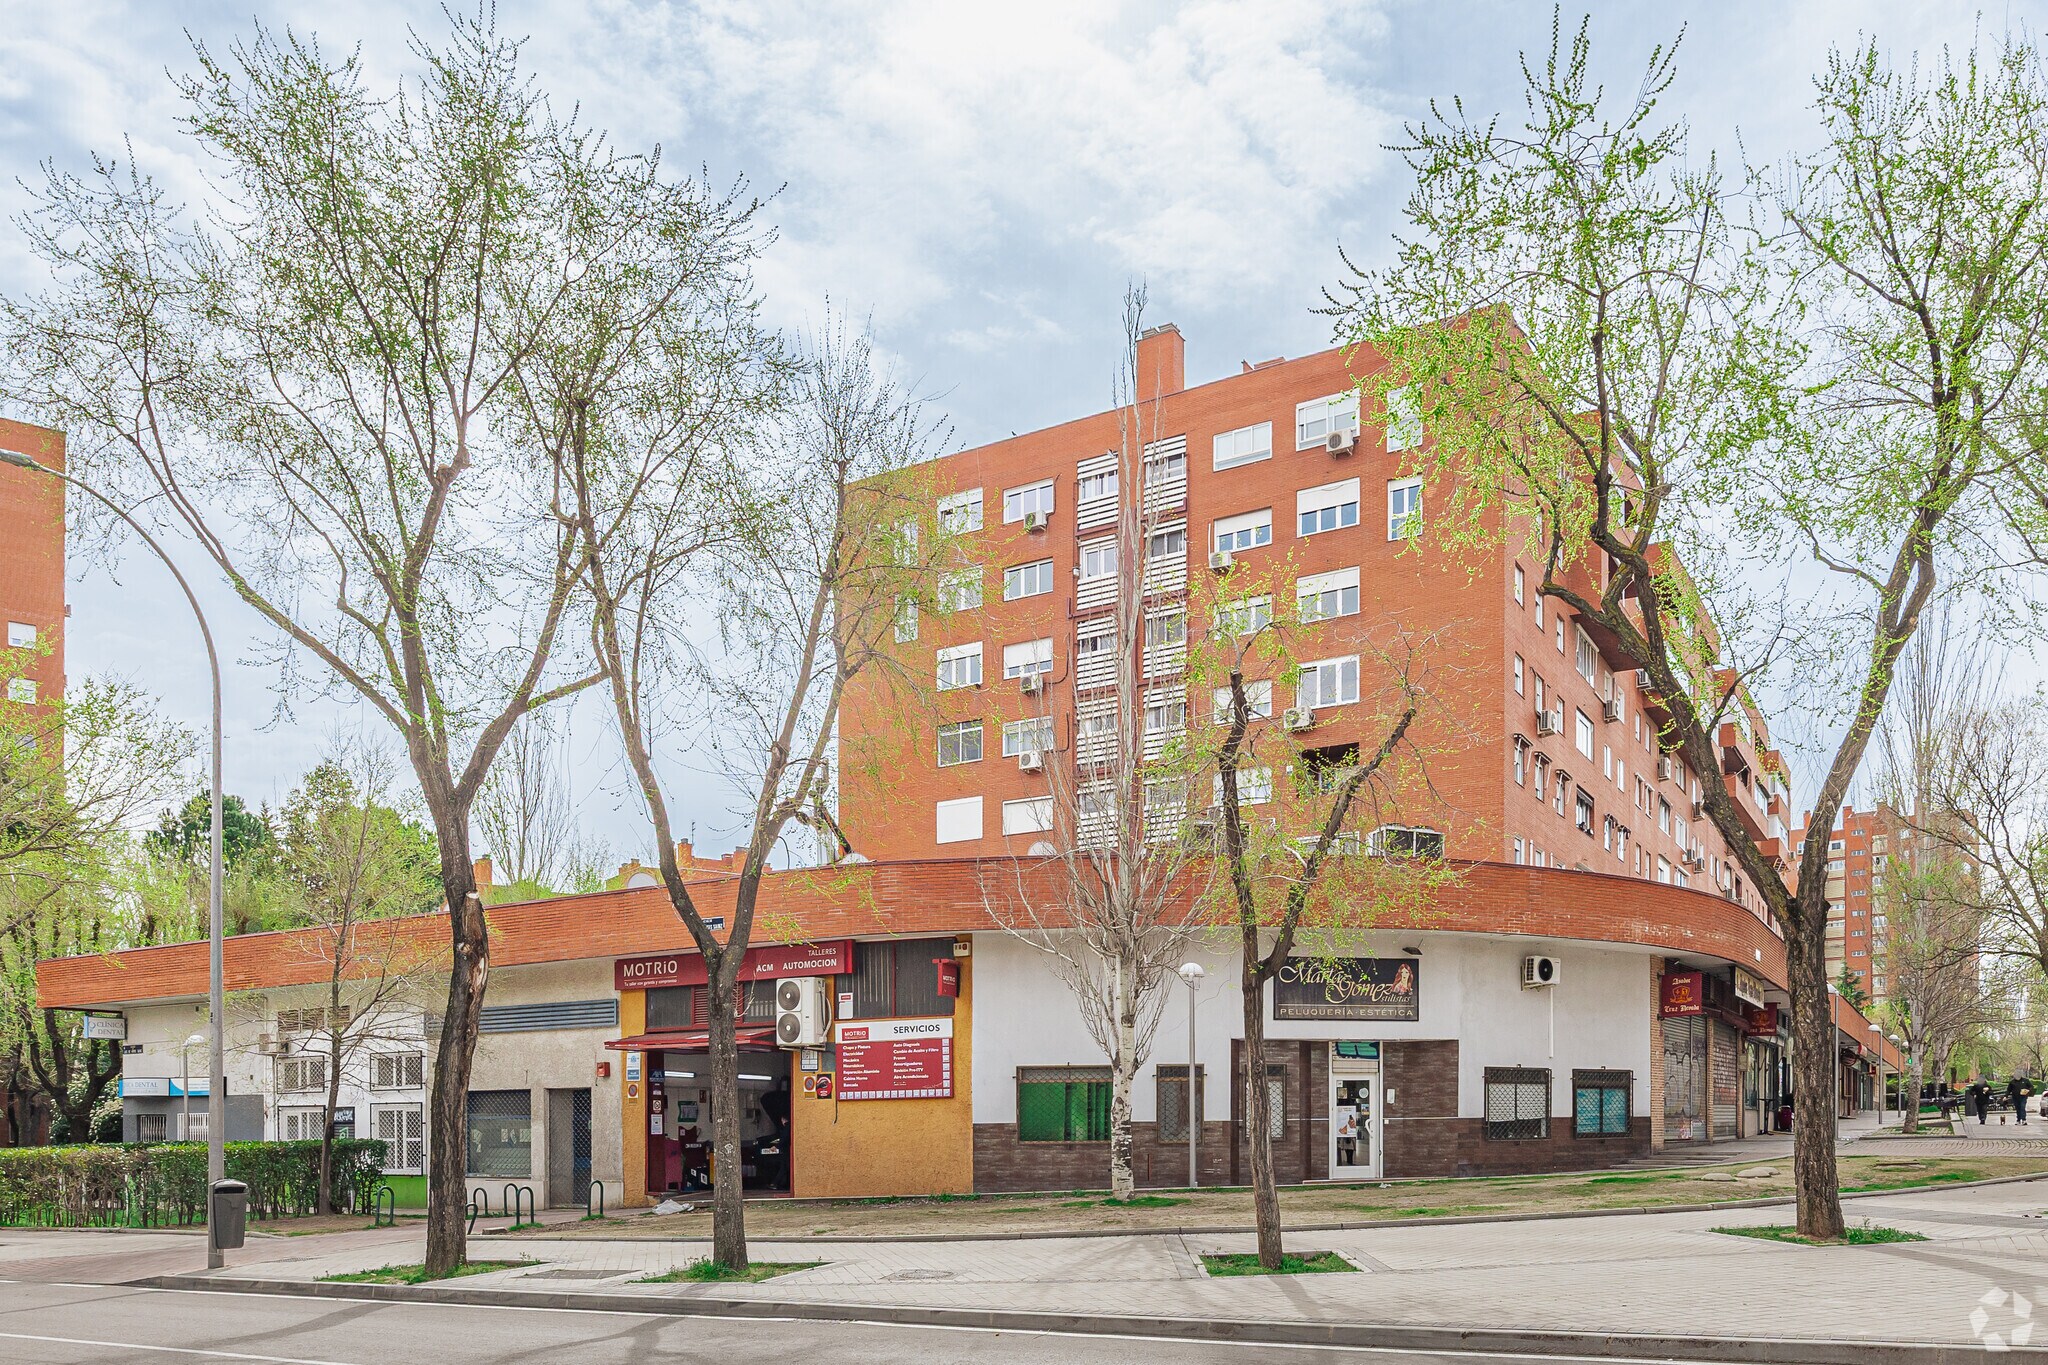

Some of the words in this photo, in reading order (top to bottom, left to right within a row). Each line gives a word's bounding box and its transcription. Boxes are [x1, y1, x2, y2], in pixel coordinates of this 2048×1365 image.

[808, 948, 836, 957] TALLERES
[756, 963, 773, 972] ACM
[783, 959, 837, 970] AUTOMOCION
[1280, 1006, 1354, 1016] PELUQUERÍA
[1360, 1007, 1413, 1016] ESTÉTICA
[893, 1024, 940, 1034] SERVICIOS
